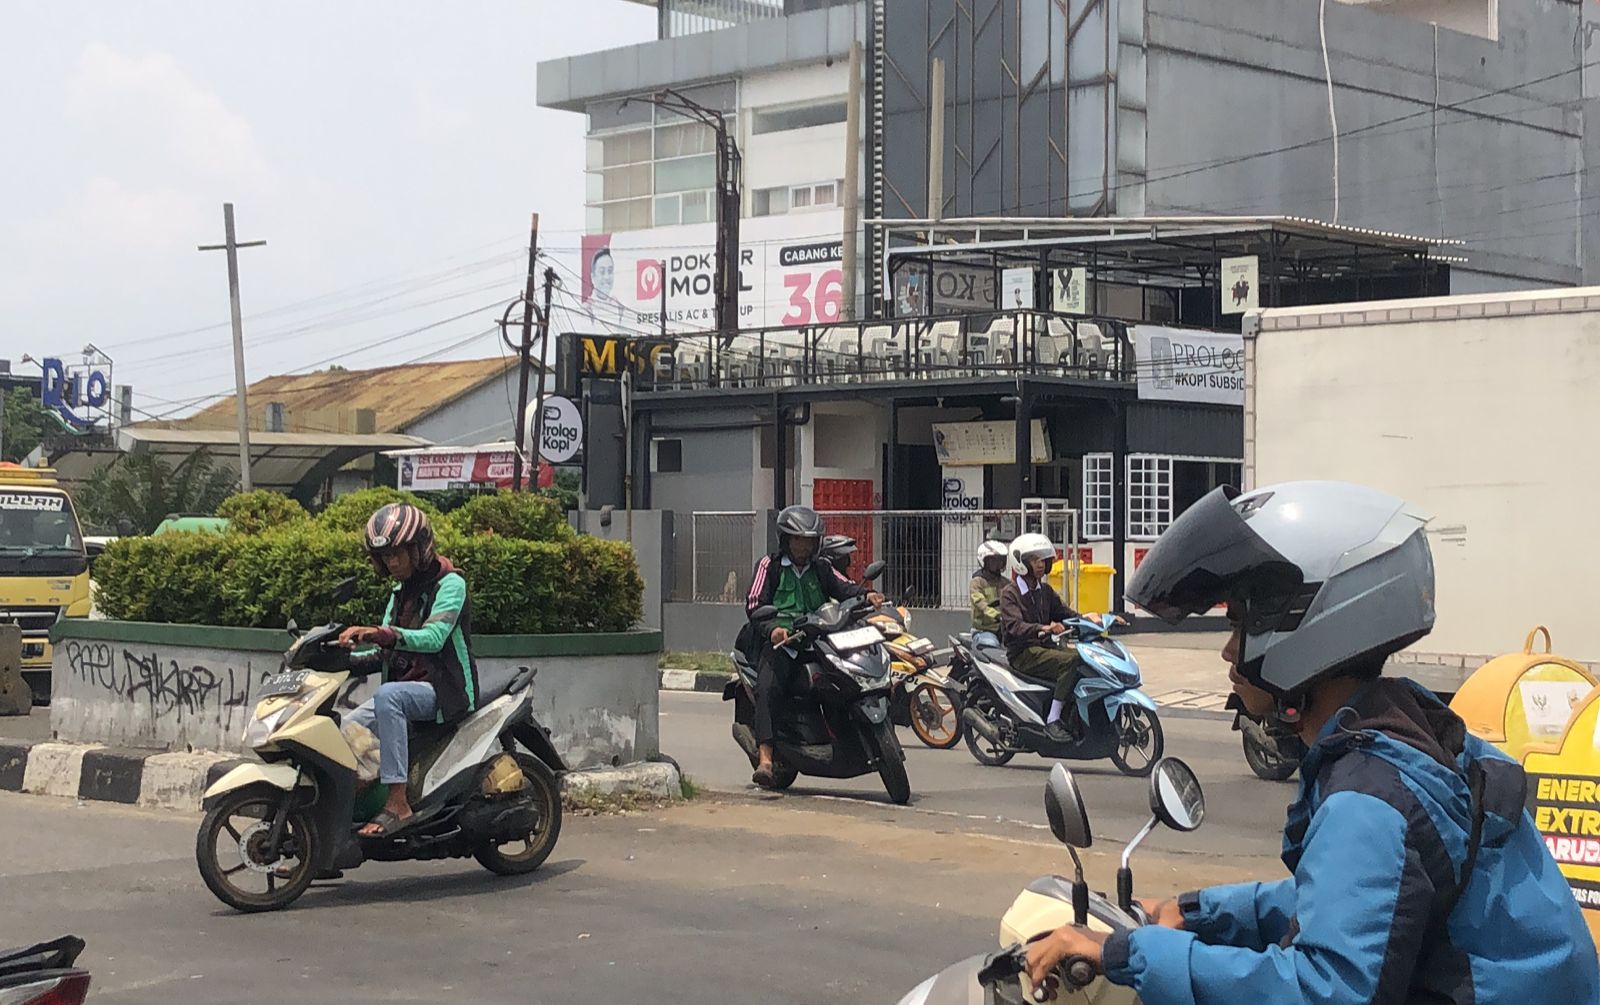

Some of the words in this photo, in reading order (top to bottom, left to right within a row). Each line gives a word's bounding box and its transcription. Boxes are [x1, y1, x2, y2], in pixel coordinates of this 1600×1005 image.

[671, 249, 753, 272] DOKR
[784, 247, 828, 262] CABANG
[671, 270, 752, 298] MOL
[782, 269, 844, 327] 36
[636, 311, 683, 324] SPESALIS
[686, 309, 700, 321] AC
[702, 308, 709, 319] &
[740, 305, 754, 316] UP
[1175, 371, 1206, 388] #KOPI
[543, 436, 570, 453] Kopi
[1545, 837, 1600, 863] ARUD
